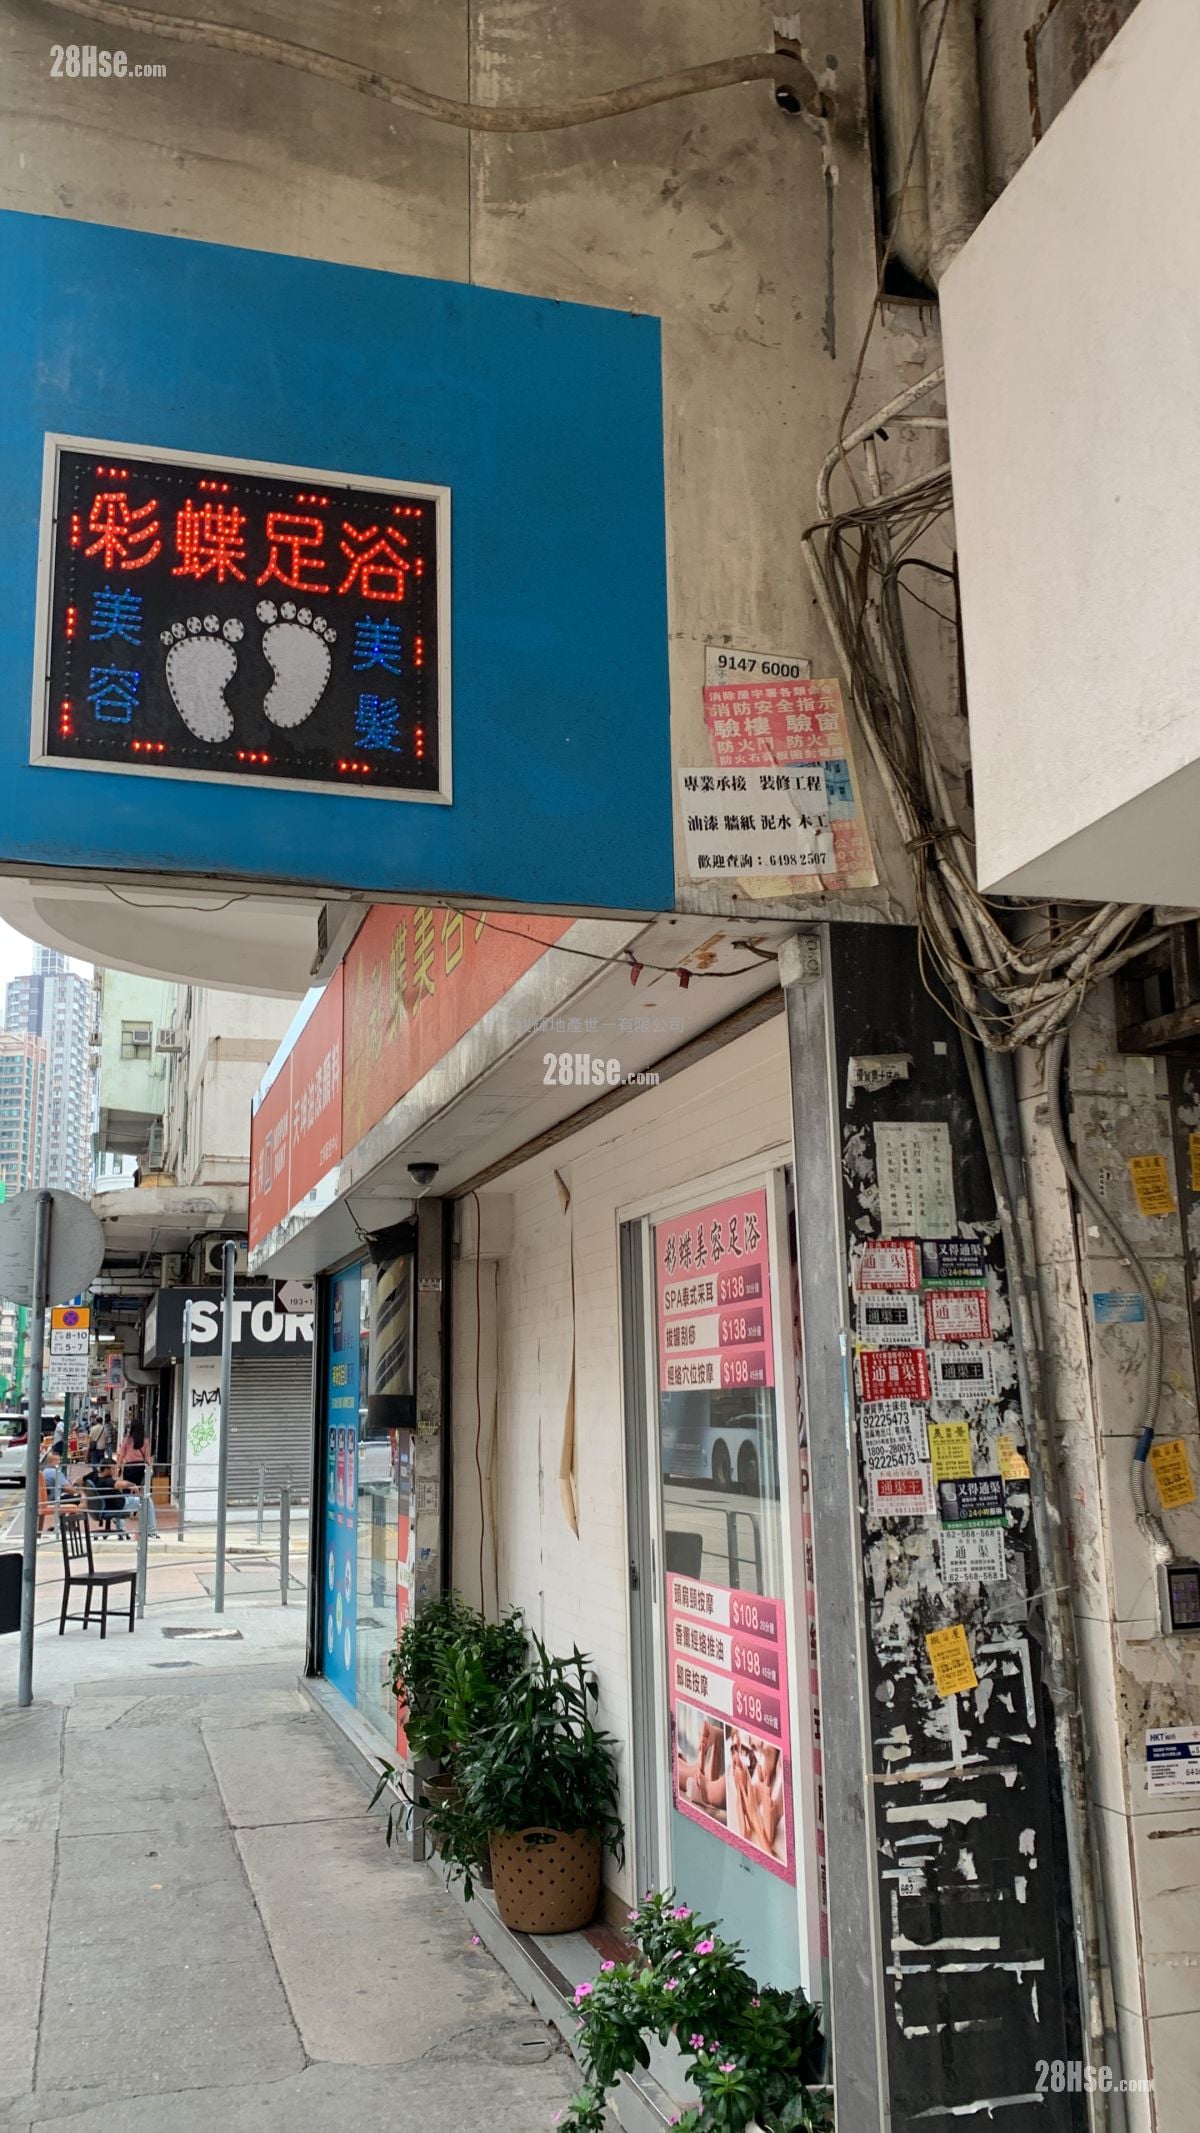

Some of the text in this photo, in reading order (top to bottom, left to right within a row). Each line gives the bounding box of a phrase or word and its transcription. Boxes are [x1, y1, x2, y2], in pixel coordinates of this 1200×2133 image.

[85, 492, 410, 601] 彩蝶足浴
[88, 585, 143, 724] 美容
[718, 655, 800, 679] 9147 6000
[353, 615, 402, 752] 美髮
[711, 696, 837, 717] 消防安全指示
[714, 712, 840, 739] 驗樓 驗窗
[717, 736, 775, 755] 防火門
[684, 774, 823, 793] 專業承接 裝修工程
[688, 815, 720, 832] 油漆
[761, 814, 792, 831] 泥水
[798, 814, 828, 830] 木工
[769, 854, 797, 867] 6498
[800, 852, 826, 867] 2507
[664, 1214, 761, 1274] 彩蝶美容足浴
[665, 1281, 714, 1310] SPA泰式采耳
[720, 1276, 744, 1300] $138
[868, 1309, 907, 1324] 通渠王
[65, 1331, 87, 1340] 8-10
[722, 1318, 746, 1342] $138
[65, 1343, 83, 1351] 5-7
[667, 1362, 714, 1386] 經絡穴位按摩
[723, 1359, 748, 1383] $198
[944, 1364, 983, 1378] 通渠王
[863, 1411, 910, 1429] 92225473
[868, 1451, 916, 1471] 92225473
[880, 1480, 921, 1495] 通渠王
[946, 1530, 995, 1538] 62-568-568
[949, 1572, 998, 1582] 62-568-568
[732, 1600, 759, 1629] $108
[734, 1645, 760, 1675] $198
[676, 1664, 709, 1697] 腳底按摩
[736, 1689, 762, 1722] $198
[1150, 1733, 1164, 1741] HKT
